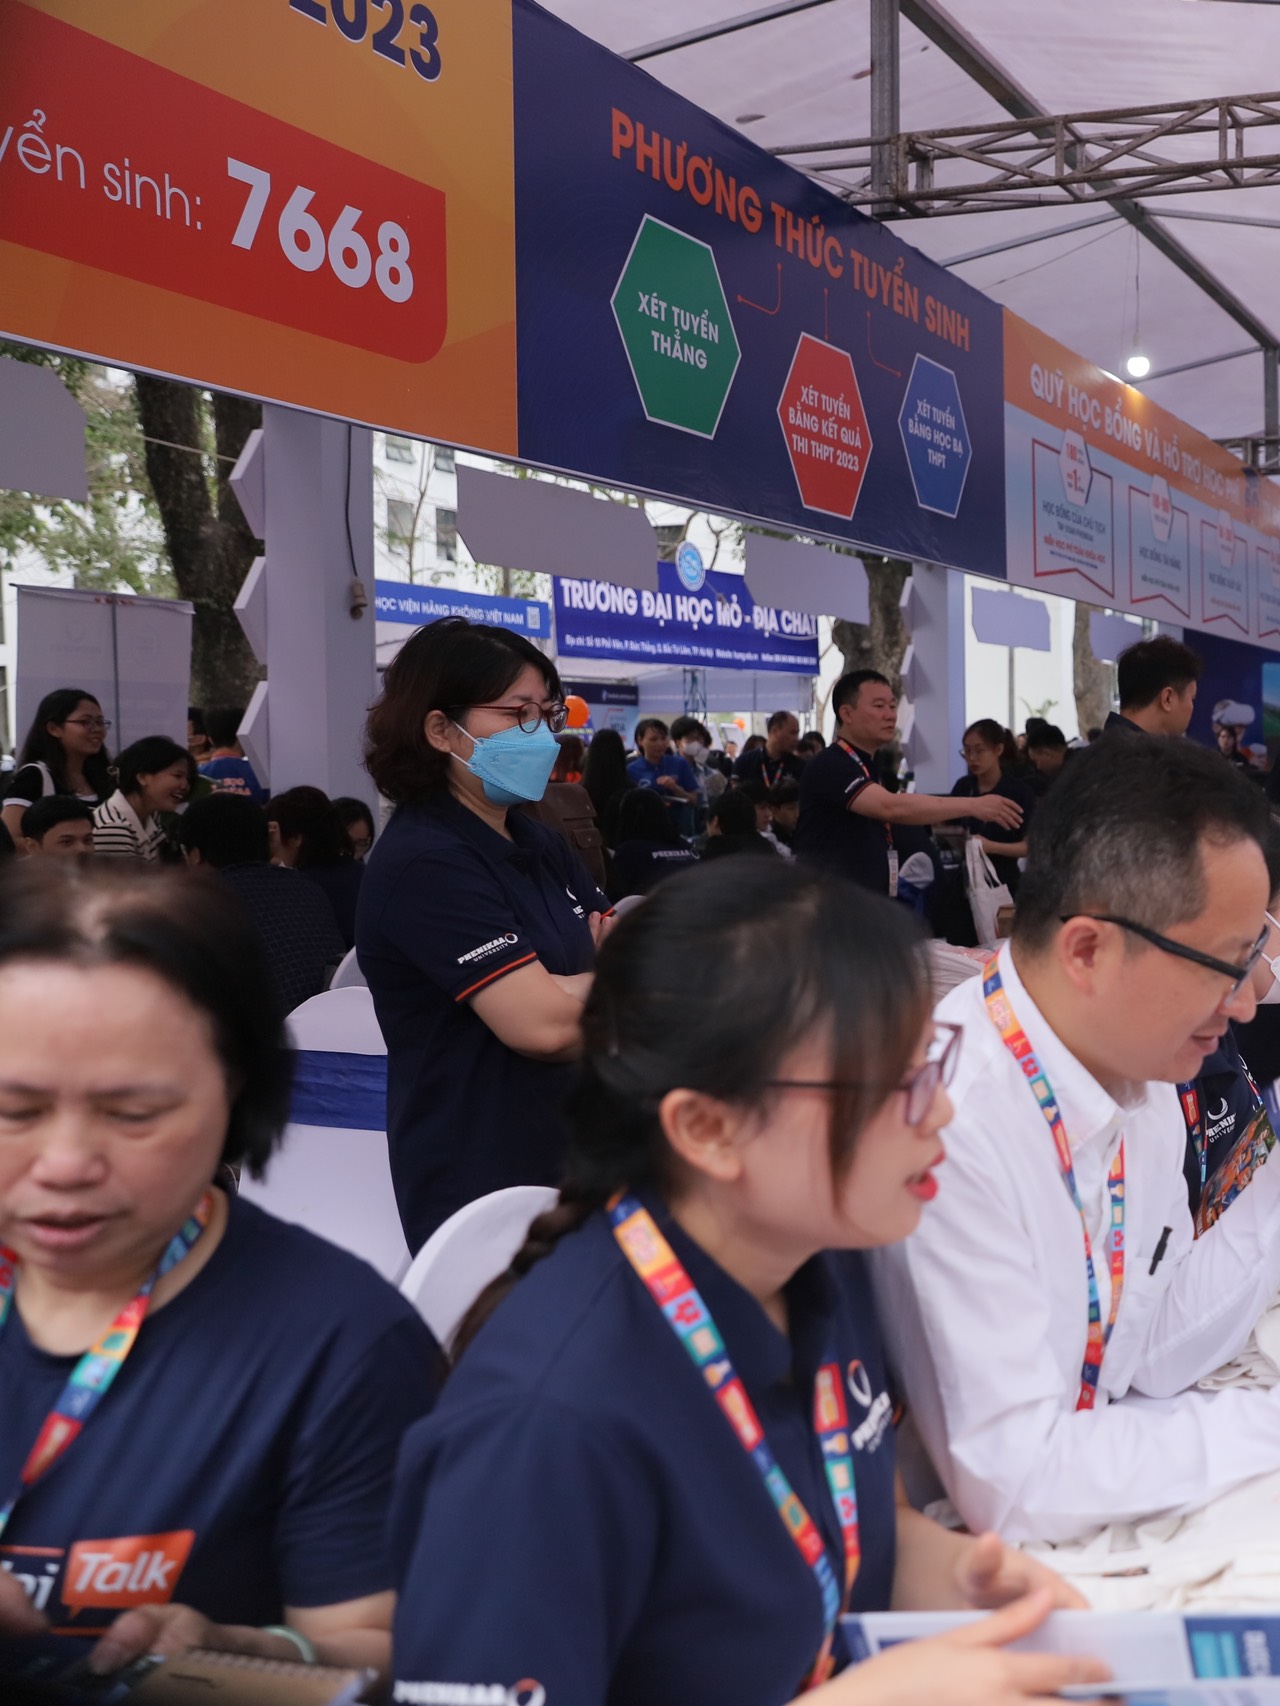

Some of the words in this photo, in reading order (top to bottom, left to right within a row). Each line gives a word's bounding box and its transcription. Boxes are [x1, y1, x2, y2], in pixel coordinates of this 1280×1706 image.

[103, 158, 202, 231] sinh:
[227, 156, 415, 304] 7668
[611, 106, 763, 234] PHƯƠNG
[770, 200, 845, 279] THỨC
[850, 248, 920, 324] TUYỂN
[925, 294, 970, 352] SINH
[637, 290, 668, 322] XÉT
[671, 306, 719, 345] TUYỂN
[801, 385, 819, 408] XÉT
[821, 393, 851, 421] TUYỂN
[1030, 362, 1065, 409] QUỸ
[1068, 383, 1102, 432] HỌC
[1144, 426, 1162, 464] VÀ
[791, 433, 809, 455] THI
[811, 440, 834, 463] THPT
[836, 450, 860, 472] 2023
[927, 448, 947, 470] THPT
[503, 612, 524, 625] NAM
[641, 589, 673, 627] ĐẠI
[675, 594, 714, 631] HỌC
[457, 936, 506, 965] PHENIKAA
[75, 1551, 177, 1593] Talk
